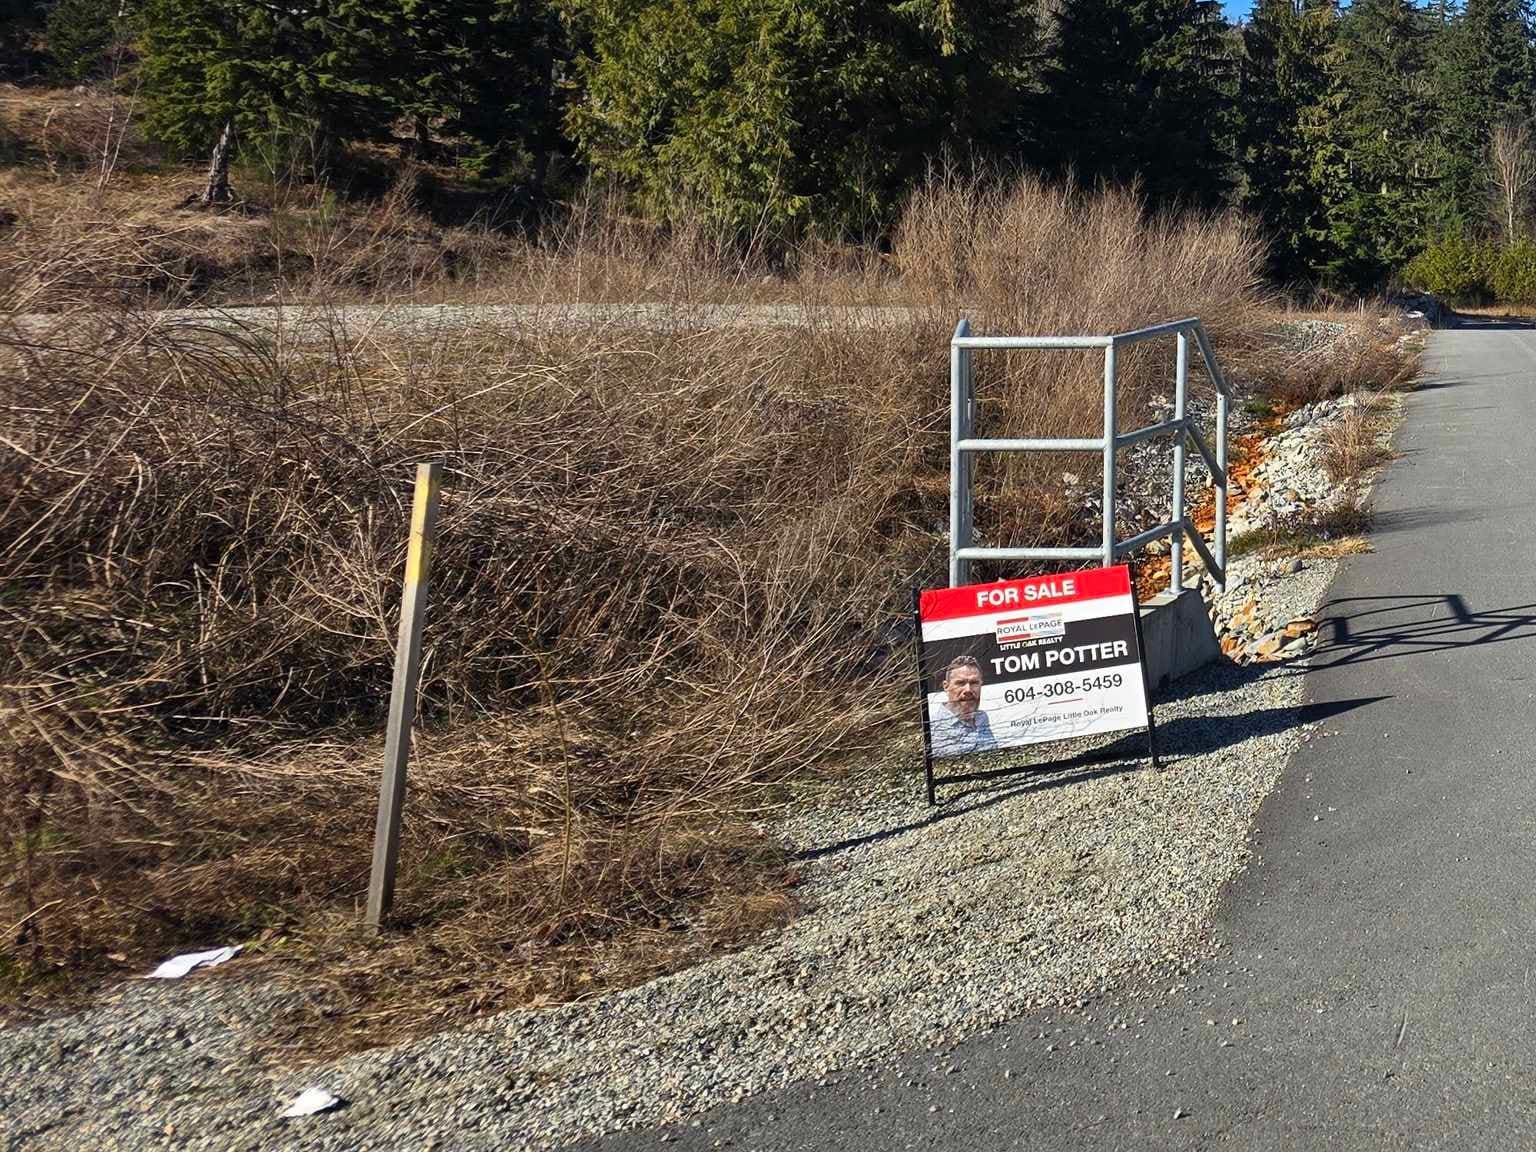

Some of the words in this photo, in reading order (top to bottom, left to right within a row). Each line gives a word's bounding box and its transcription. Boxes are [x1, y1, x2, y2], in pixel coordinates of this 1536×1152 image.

[977, 589, 1019, 608] FOR
[1024, 580, 1076, 600] SALE
[997, 626, 1026, 635] ROYAL
[1022, 639, 1037, 648] OAK
[1038, 636, 1063, 645] REALTY
[991, 654, 1039, 674] TOM
[1046, 640, 1127, 667] POTTER
[1004, 674, 1122, 703] 604-308-5459
